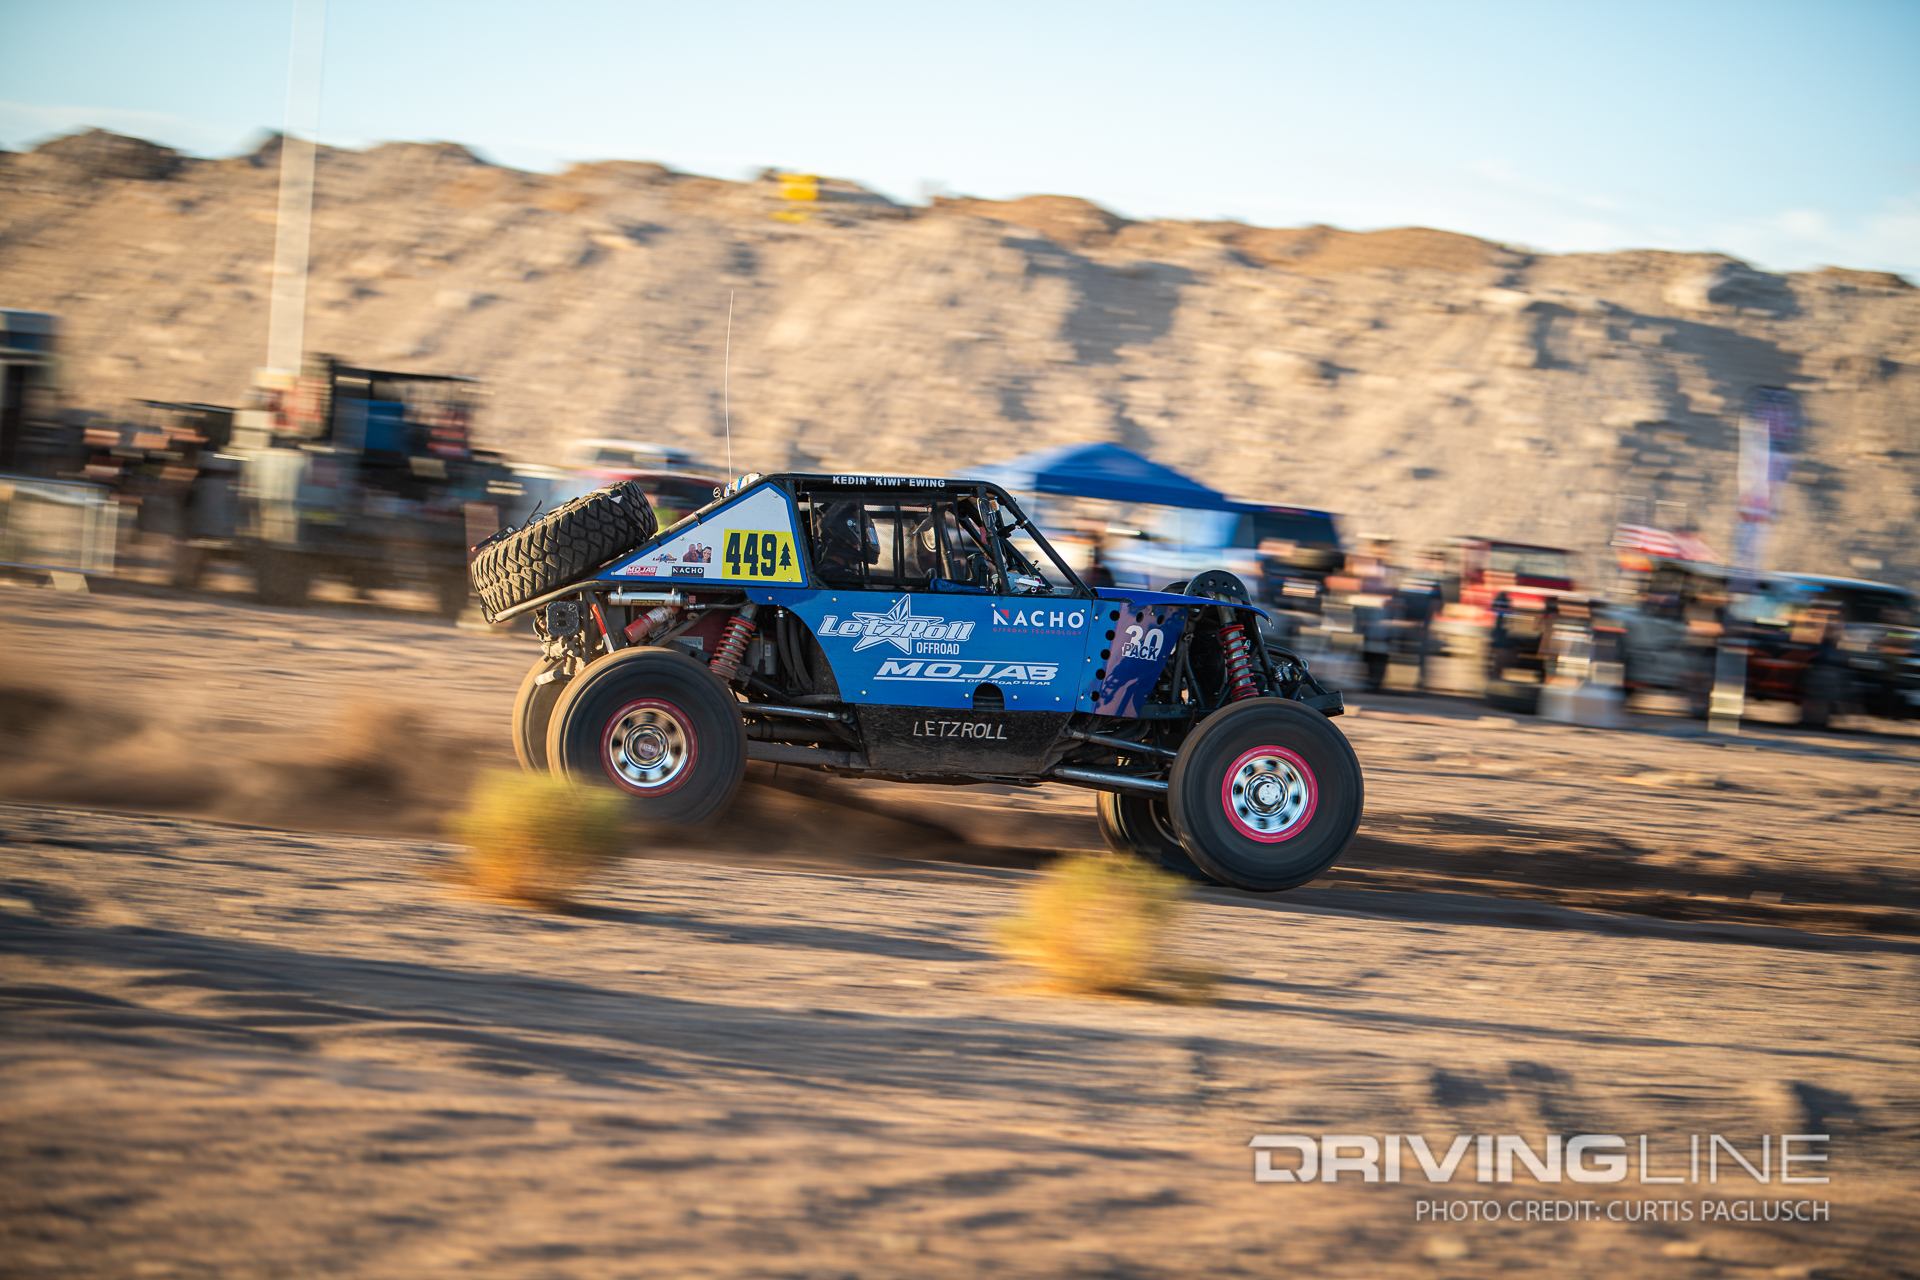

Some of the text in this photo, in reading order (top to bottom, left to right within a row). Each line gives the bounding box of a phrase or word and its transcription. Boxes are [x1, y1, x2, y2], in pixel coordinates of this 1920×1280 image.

[832, 476, 946, 488] KEDIN "KIWI" EWING
[726, 532, 777, 576] 449
[817, 614, 976, 642] LetzRoll
[993, 609, 1085, 629] NACHO
[1031, 628, 1082, 636] TECHNOLOGY
[1125, 624, 1164, 655] 30
[916, 641, 960, 655] OFFROAD
[1122, 642, 1159, 661] PACK
[876, 661, 1059, 681] MOJAB
[912, 720, 1008, 740] LETZROLL
